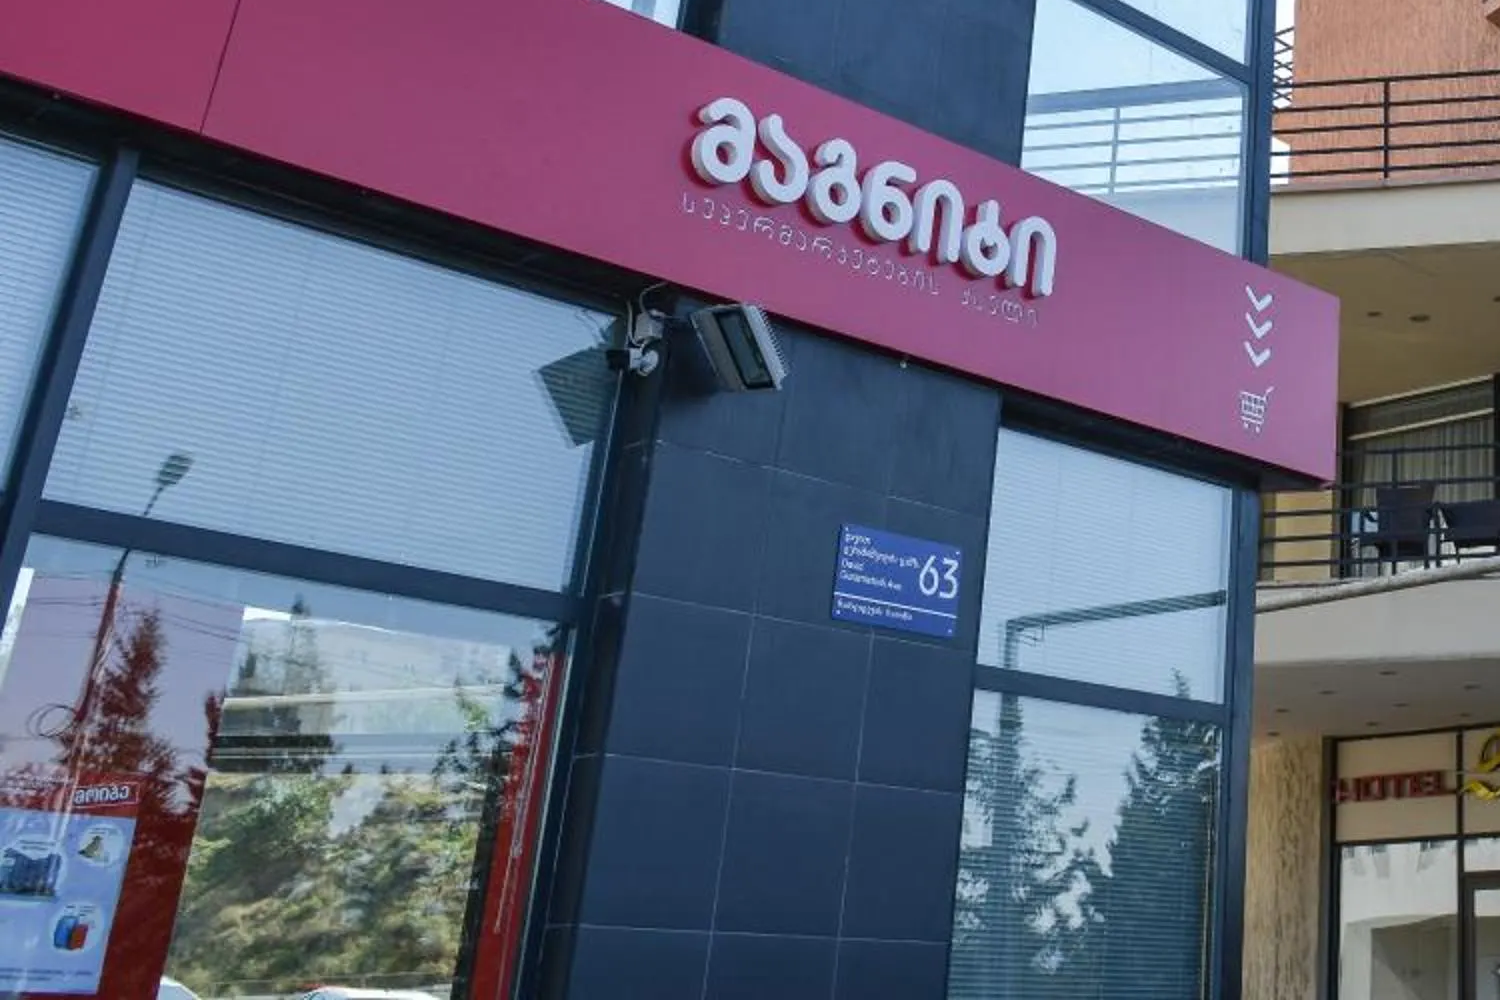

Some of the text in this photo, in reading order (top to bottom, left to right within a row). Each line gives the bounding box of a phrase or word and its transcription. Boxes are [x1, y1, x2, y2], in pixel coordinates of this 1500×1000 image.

[690, 97, 1058, 297] მაგნიტი
[919, 554, 959, 599] 63
[1335, 770, 1457, 804] HOTEL
